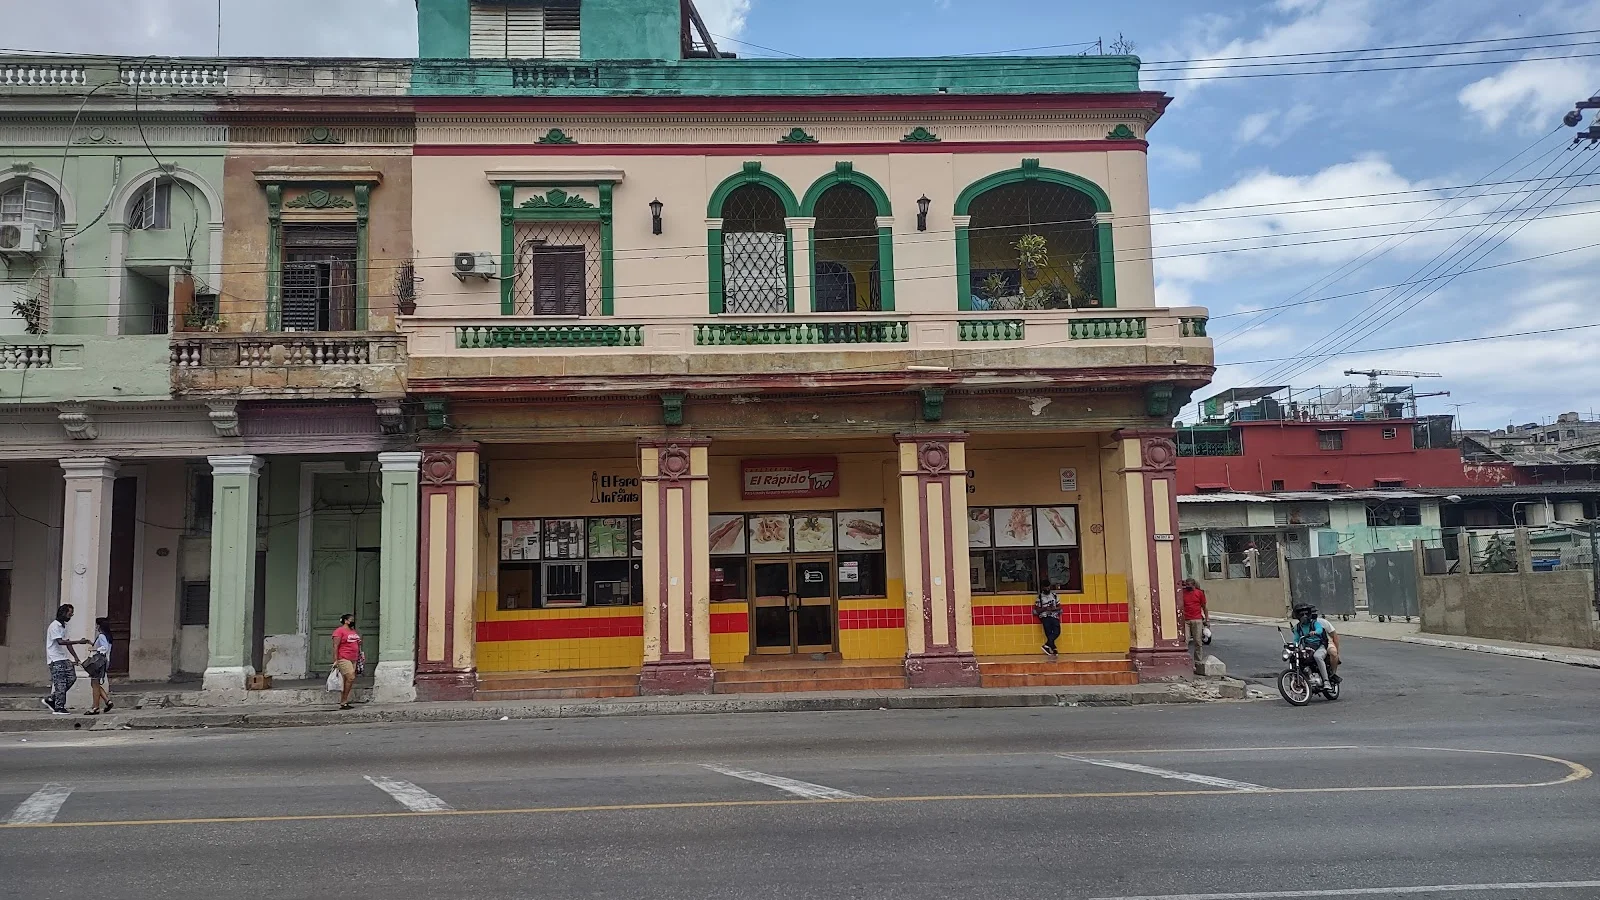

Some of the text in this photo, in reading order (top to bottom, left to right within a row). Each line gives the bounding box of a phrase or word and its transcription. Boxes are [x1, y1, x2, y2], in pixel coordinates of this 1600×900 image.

[601, 475, 639, 487] El Faro
[750, 473, 807, 487] El Rápido
[601, 491, 639, 503] Infanta
